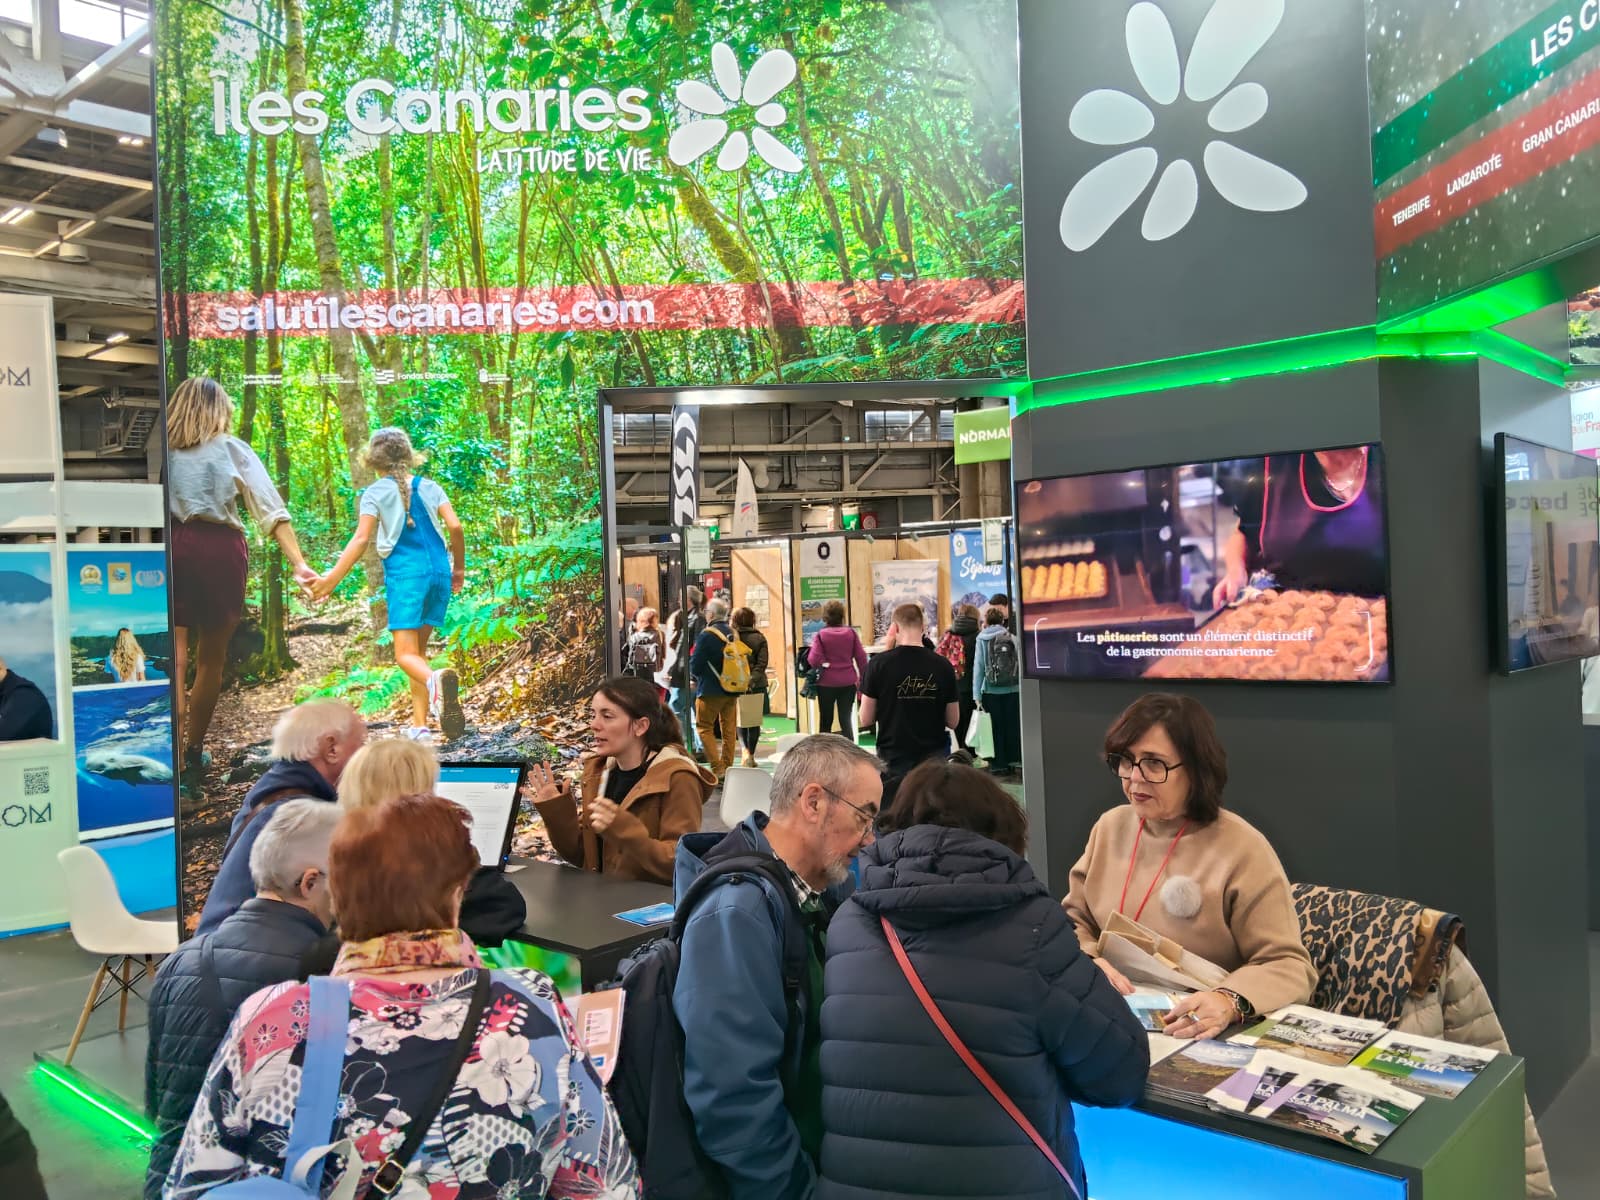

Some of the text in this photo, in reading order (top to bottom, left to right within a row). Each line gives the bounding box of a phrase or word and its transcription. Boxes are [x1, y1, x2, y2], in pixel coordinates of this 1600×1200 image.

[1529, 0, 1600, 67] LES C
[211, 70, 652, 135] Îles Canaries
[1522, 98, 1600, 153] GRAN CANARI
[477, 147, 652, 177] LATITUDE DE VIE
[1446, 153, 1503, 197] LANZAROTE
[1392, 195, 1431, 227] TENERIFE
[216, 294, 656, 332] salutîlescanaries.com
[1077, 626, 1315, 645] Les pâtisseries sont un élément distinctif
[1106, 645, 1120, 657] de
[1121, 645, 1131, 657] la
[1132, 645, 1203, 659] gastronomie
[1375, 1053, 1393, 1063] LA
[1293, 1092, 1316, 1106] LA
[1315, 1094, 1367, 1119] PALMA
